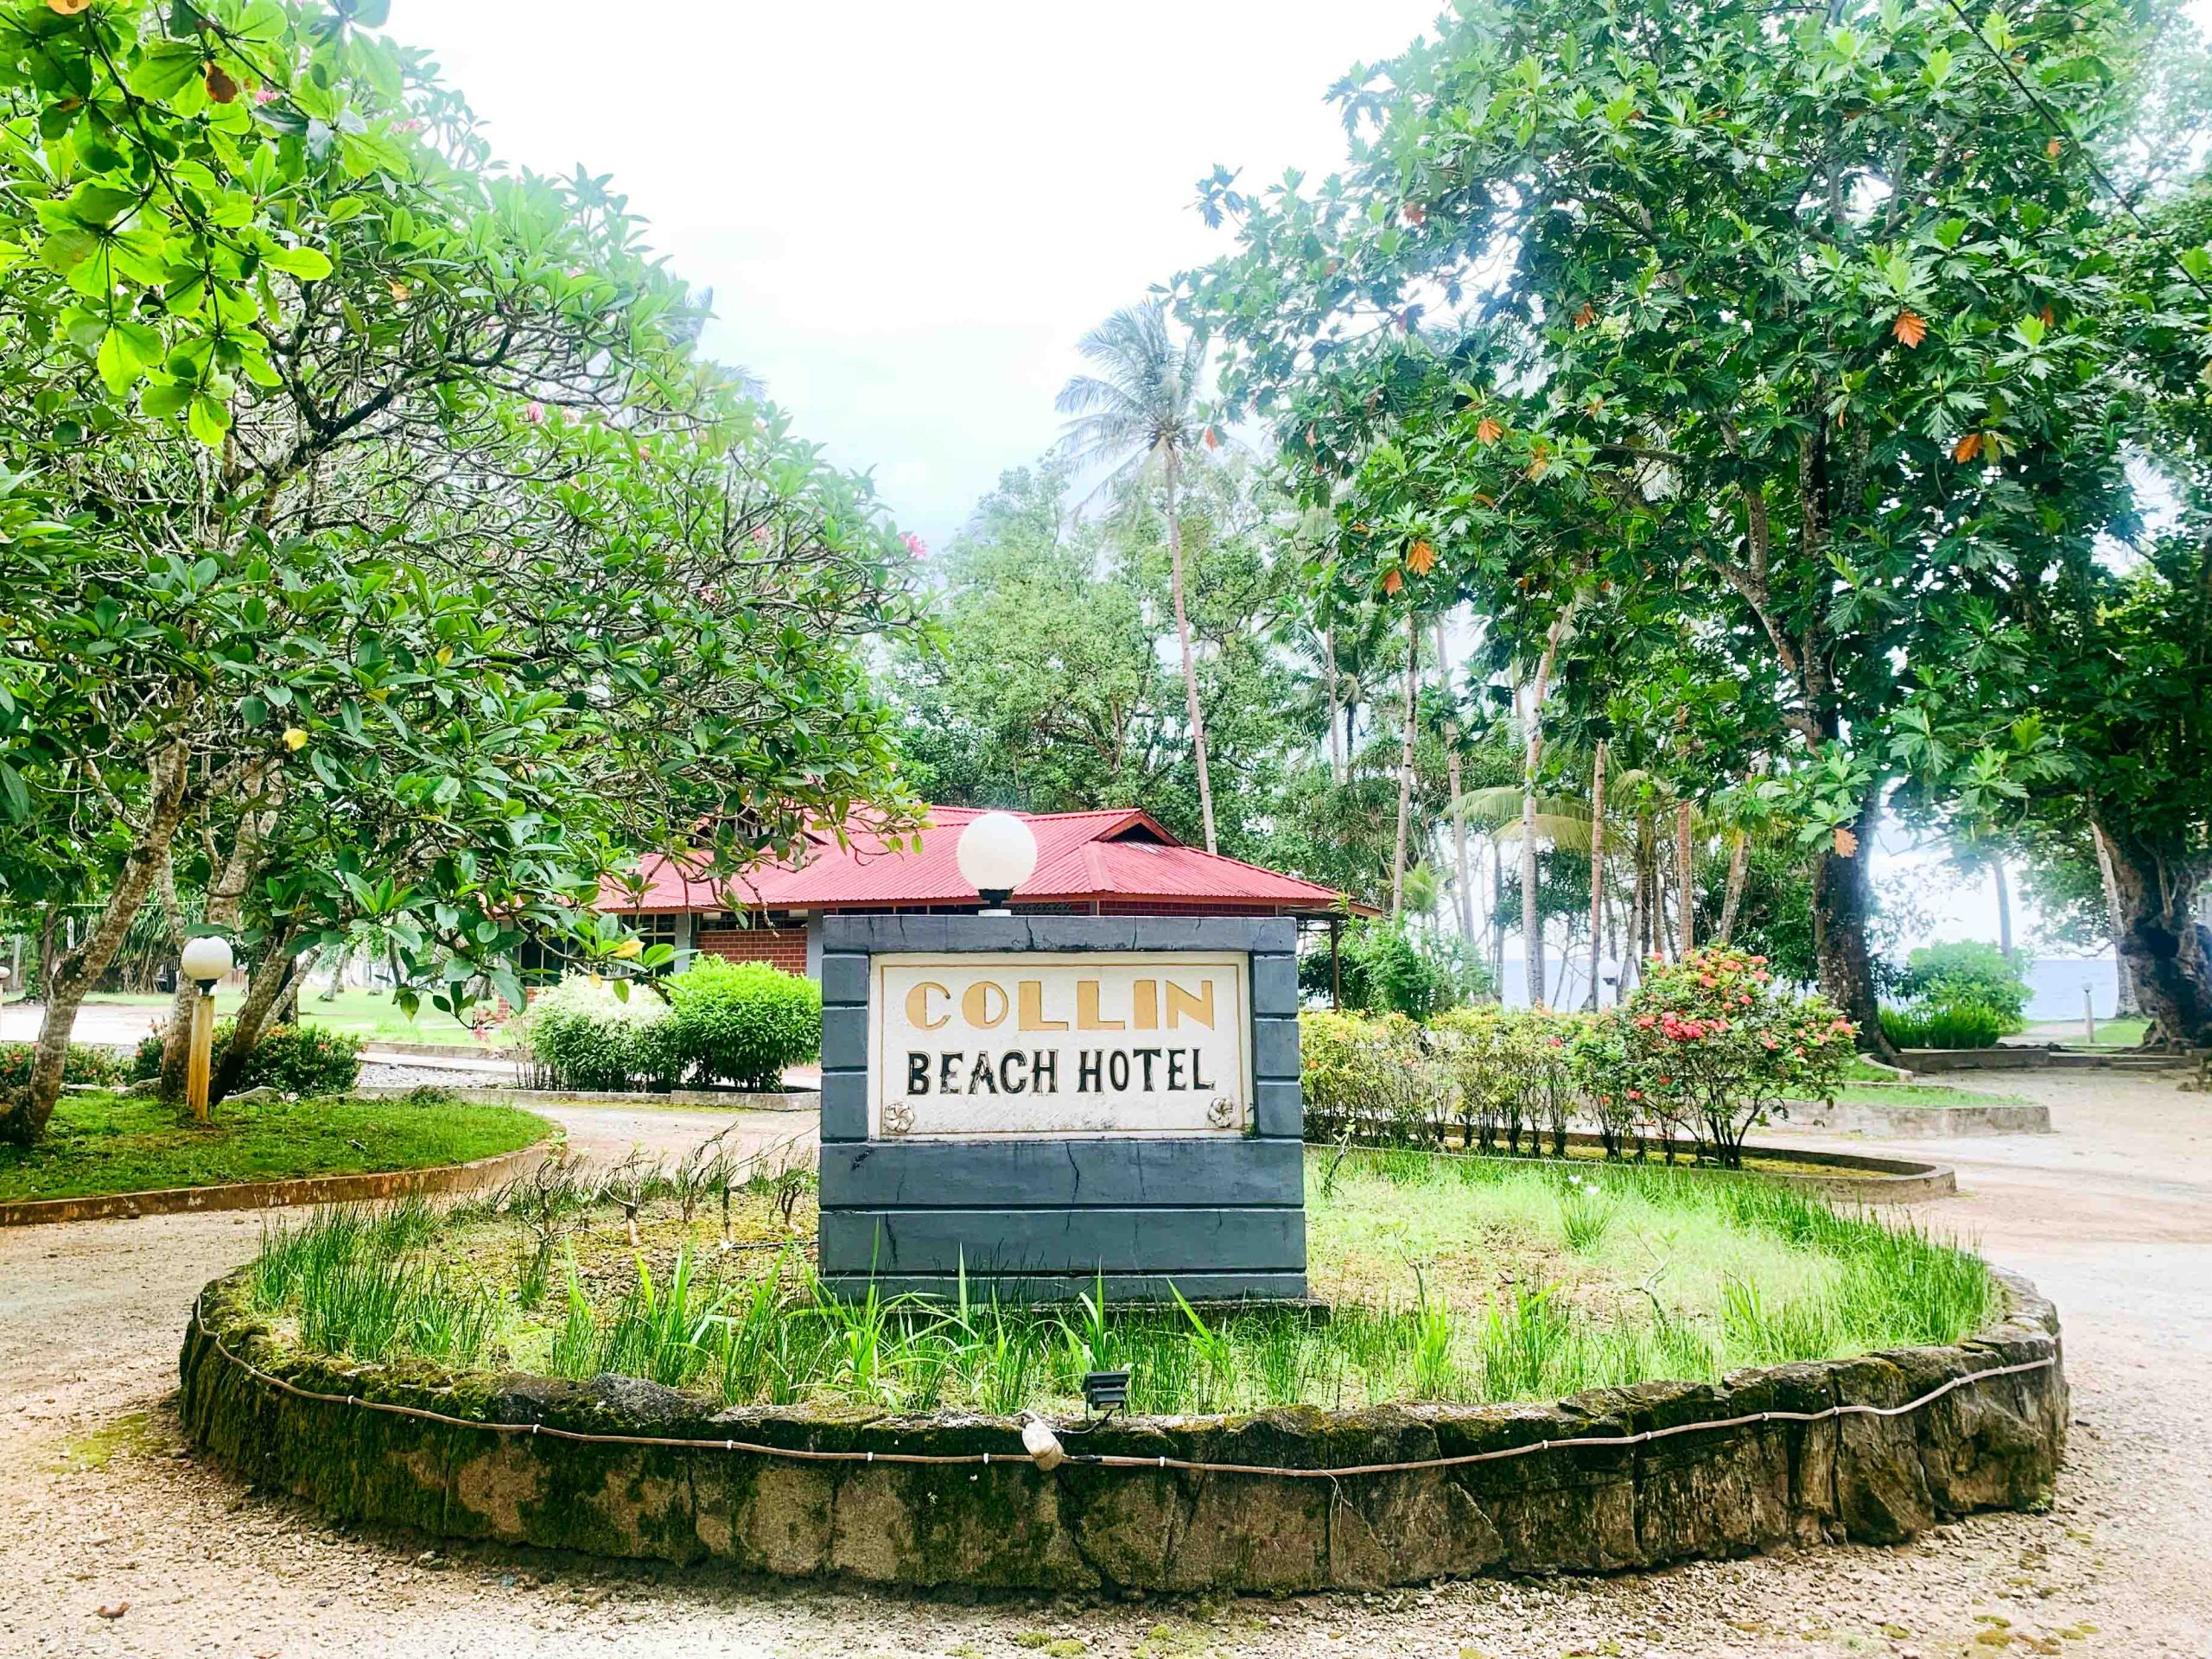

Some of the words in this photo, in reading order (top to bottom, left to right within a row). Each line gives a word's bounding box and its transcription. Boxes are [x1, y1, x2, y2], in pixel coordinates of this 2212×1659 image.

[905, 980, 1214, 1032] COLLIN
[906, 1049, 1059, 1096] BEACH
[1077, 1047, 1216, 1093] HOTEL
